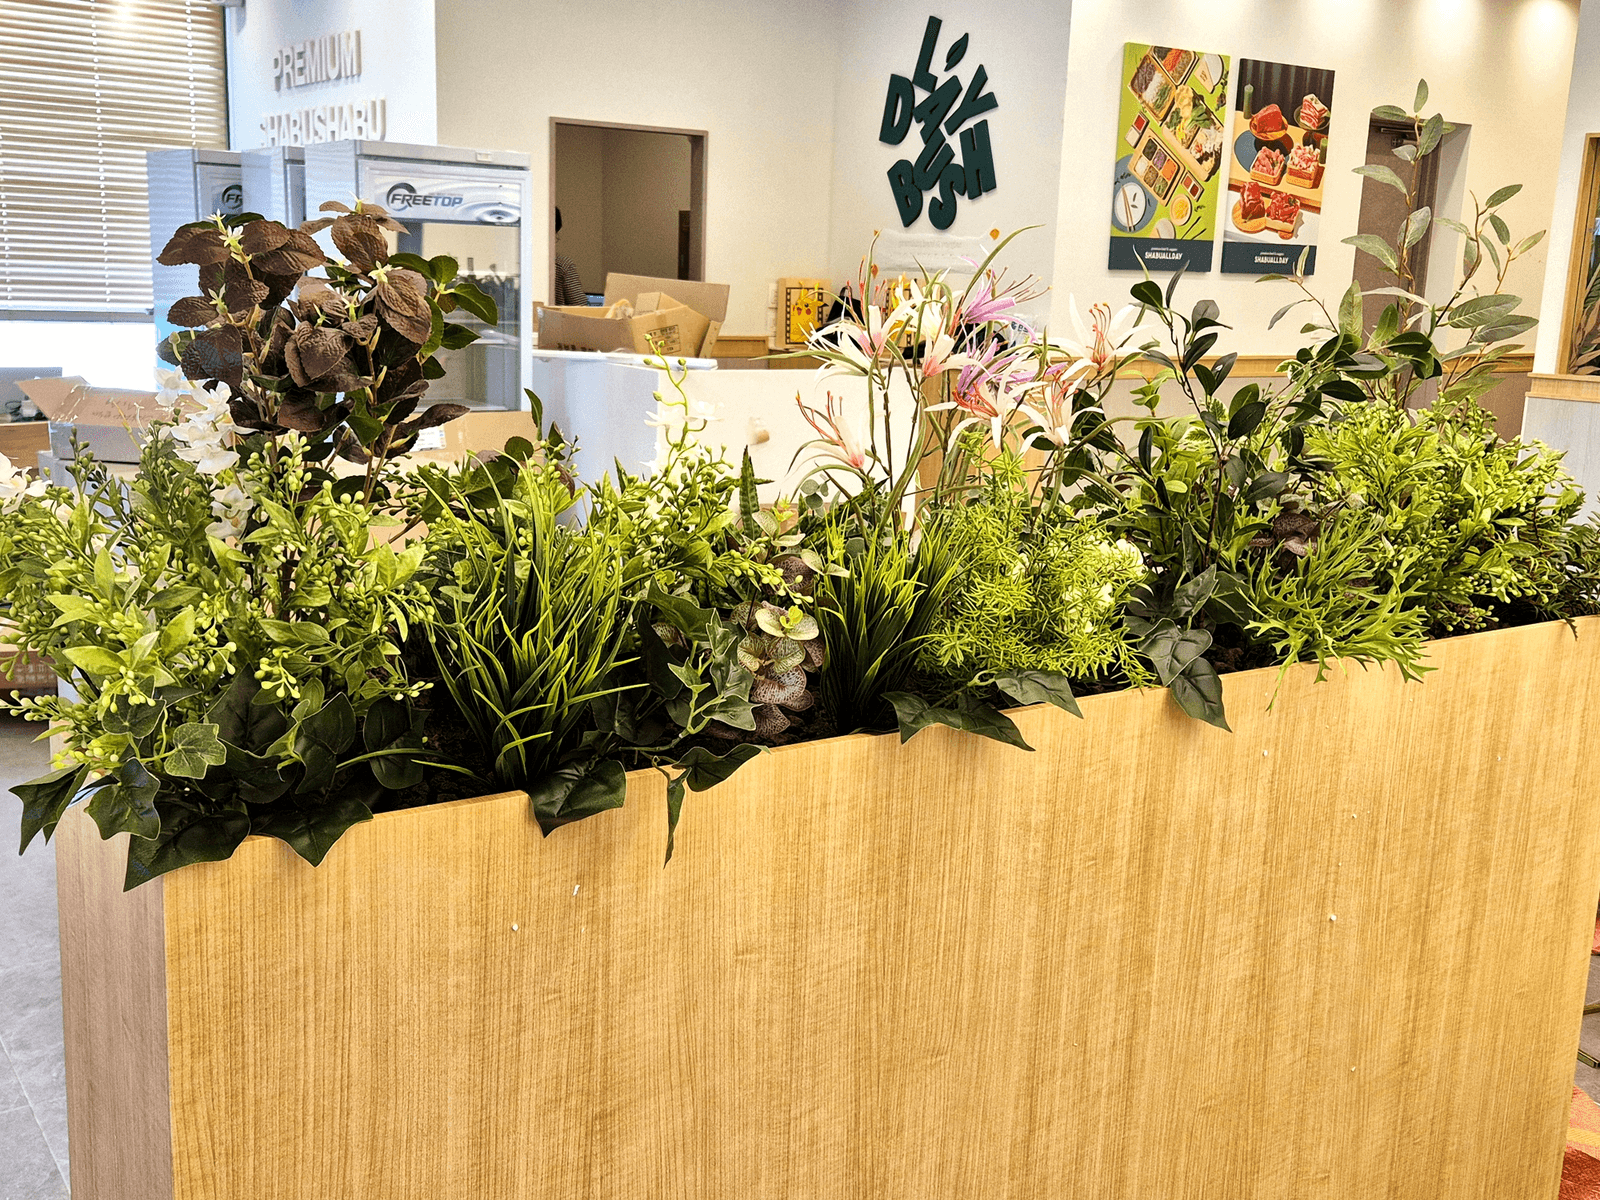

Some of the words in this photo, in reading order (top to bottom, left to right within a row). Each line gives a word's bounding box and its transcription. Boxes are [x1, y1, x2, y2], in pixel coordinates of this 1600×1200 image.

[272, 29, 361, 92] PREMIUM
[258, 97, 387, 147] SHABUSHABU
[390, 193, 464, 208] FREETOP
